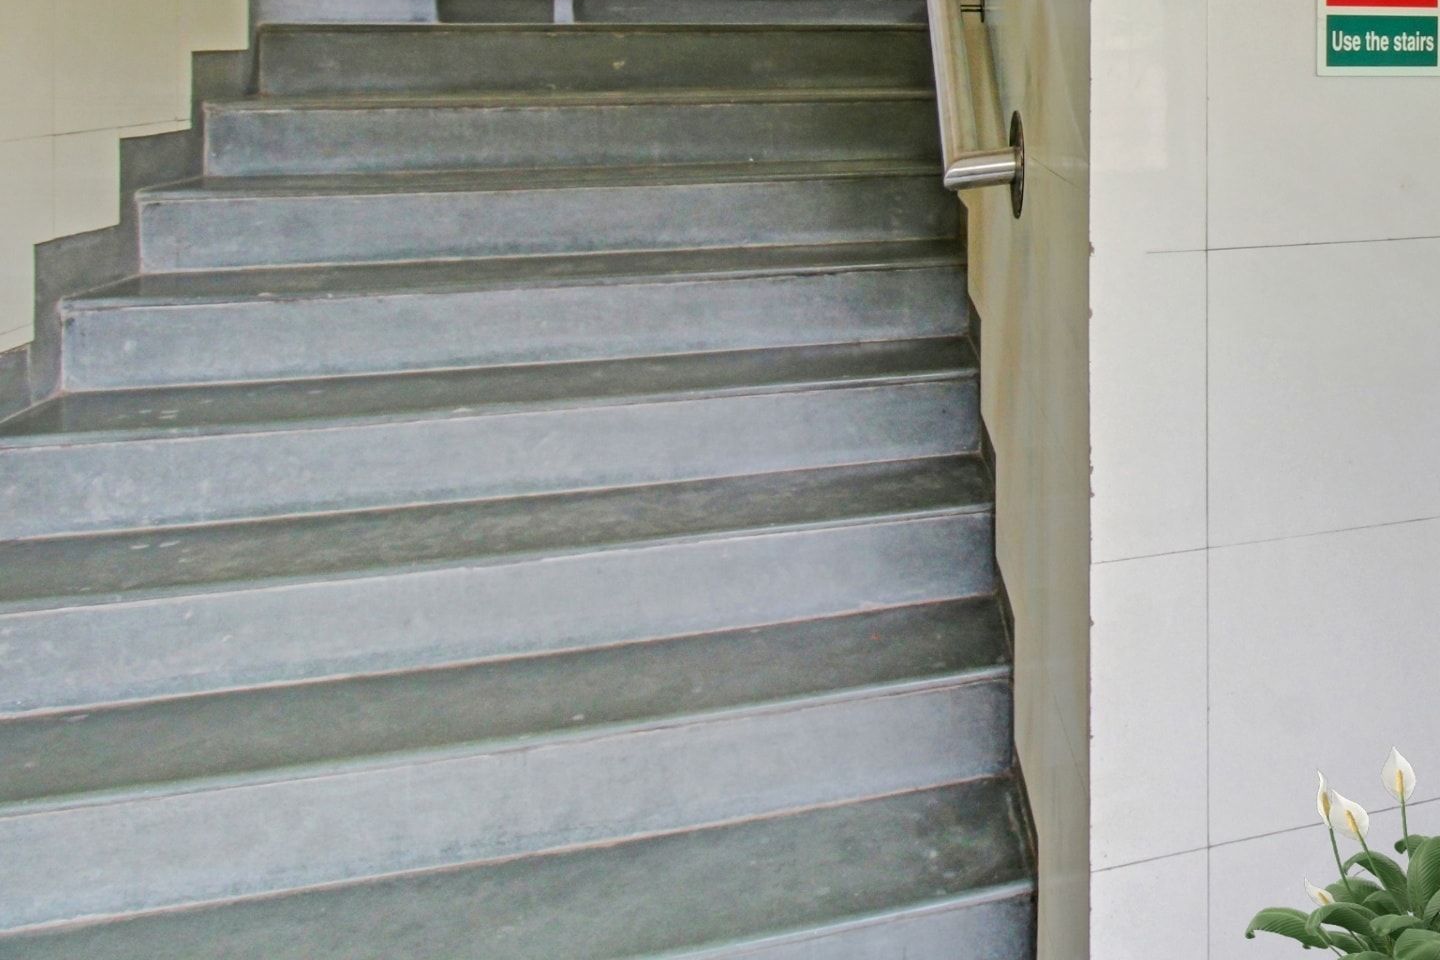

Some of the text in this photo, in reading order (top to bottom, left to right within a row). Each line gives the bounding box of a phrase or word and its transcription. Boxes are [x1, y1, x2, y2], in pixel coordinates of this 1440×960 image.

[1332, 30, 1434, 52] Use the stairs
